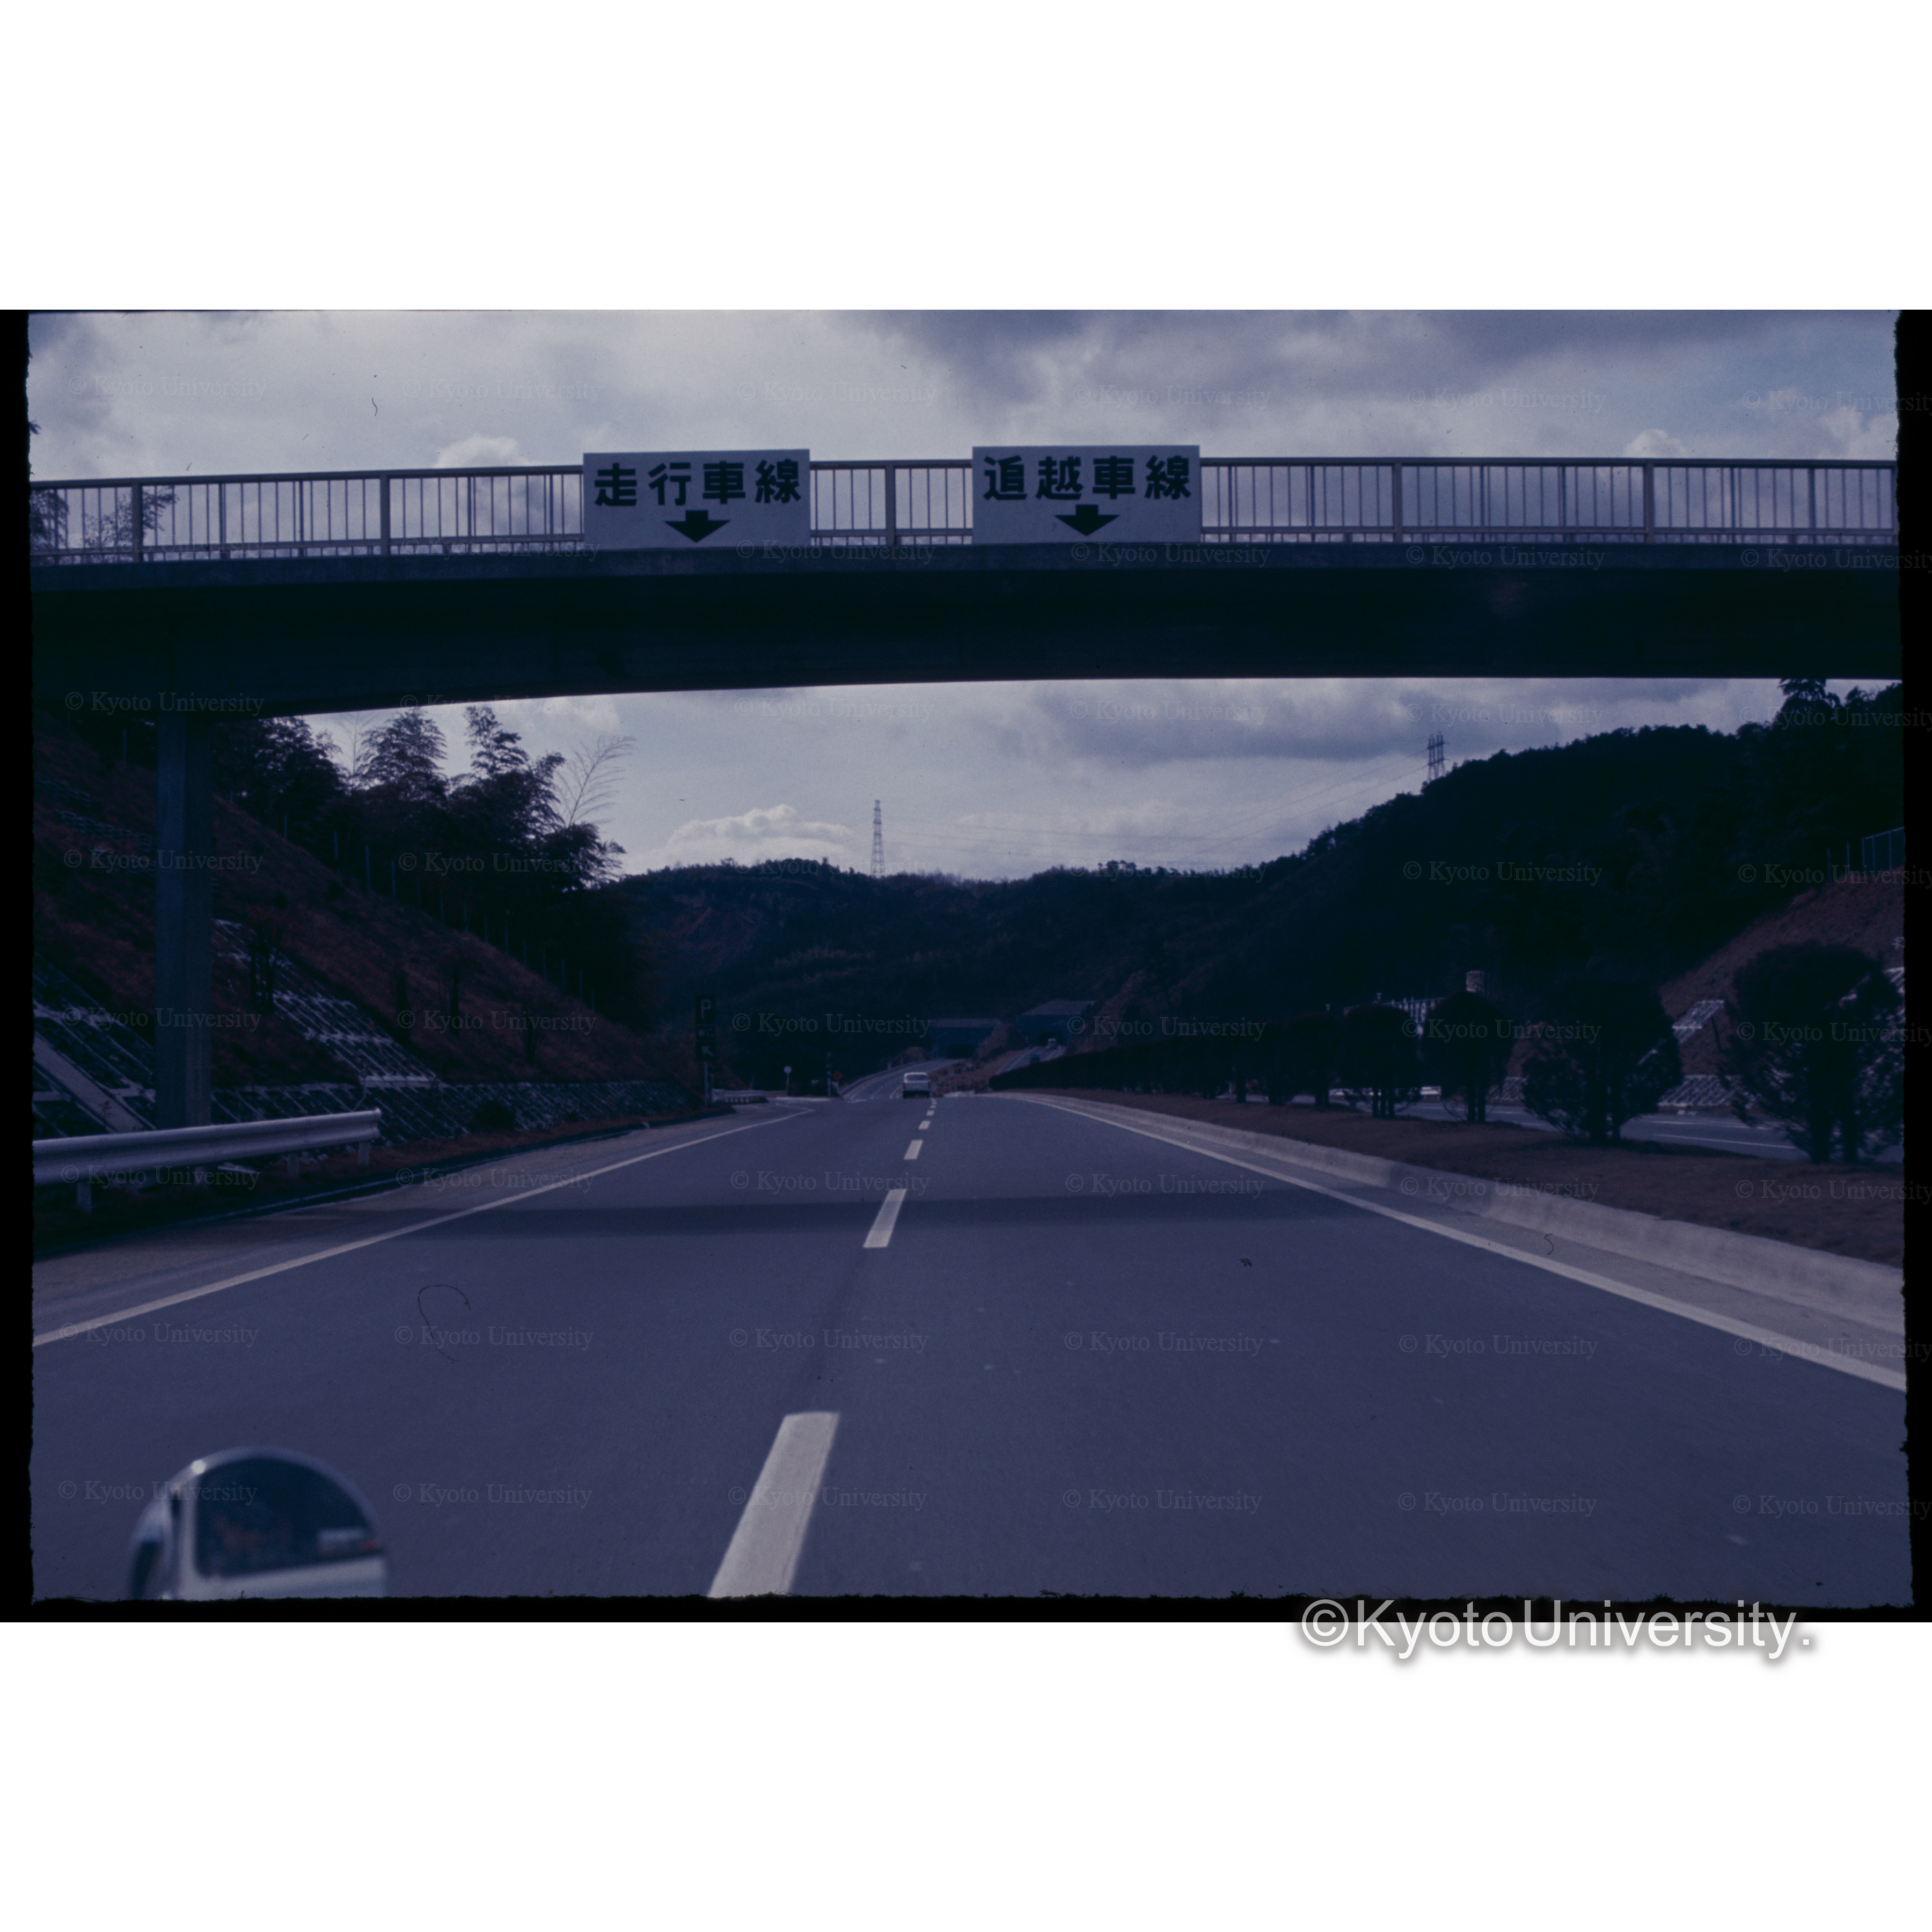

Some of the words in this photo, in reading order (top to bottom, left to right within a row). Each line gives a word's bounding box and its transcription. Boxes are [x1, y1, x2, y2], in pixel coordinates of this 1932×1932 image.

[594, 459, 801, 506] 走行車線
[983, 456, 1191, 500] 追越車線
[701, 999, 712, 1020] P
